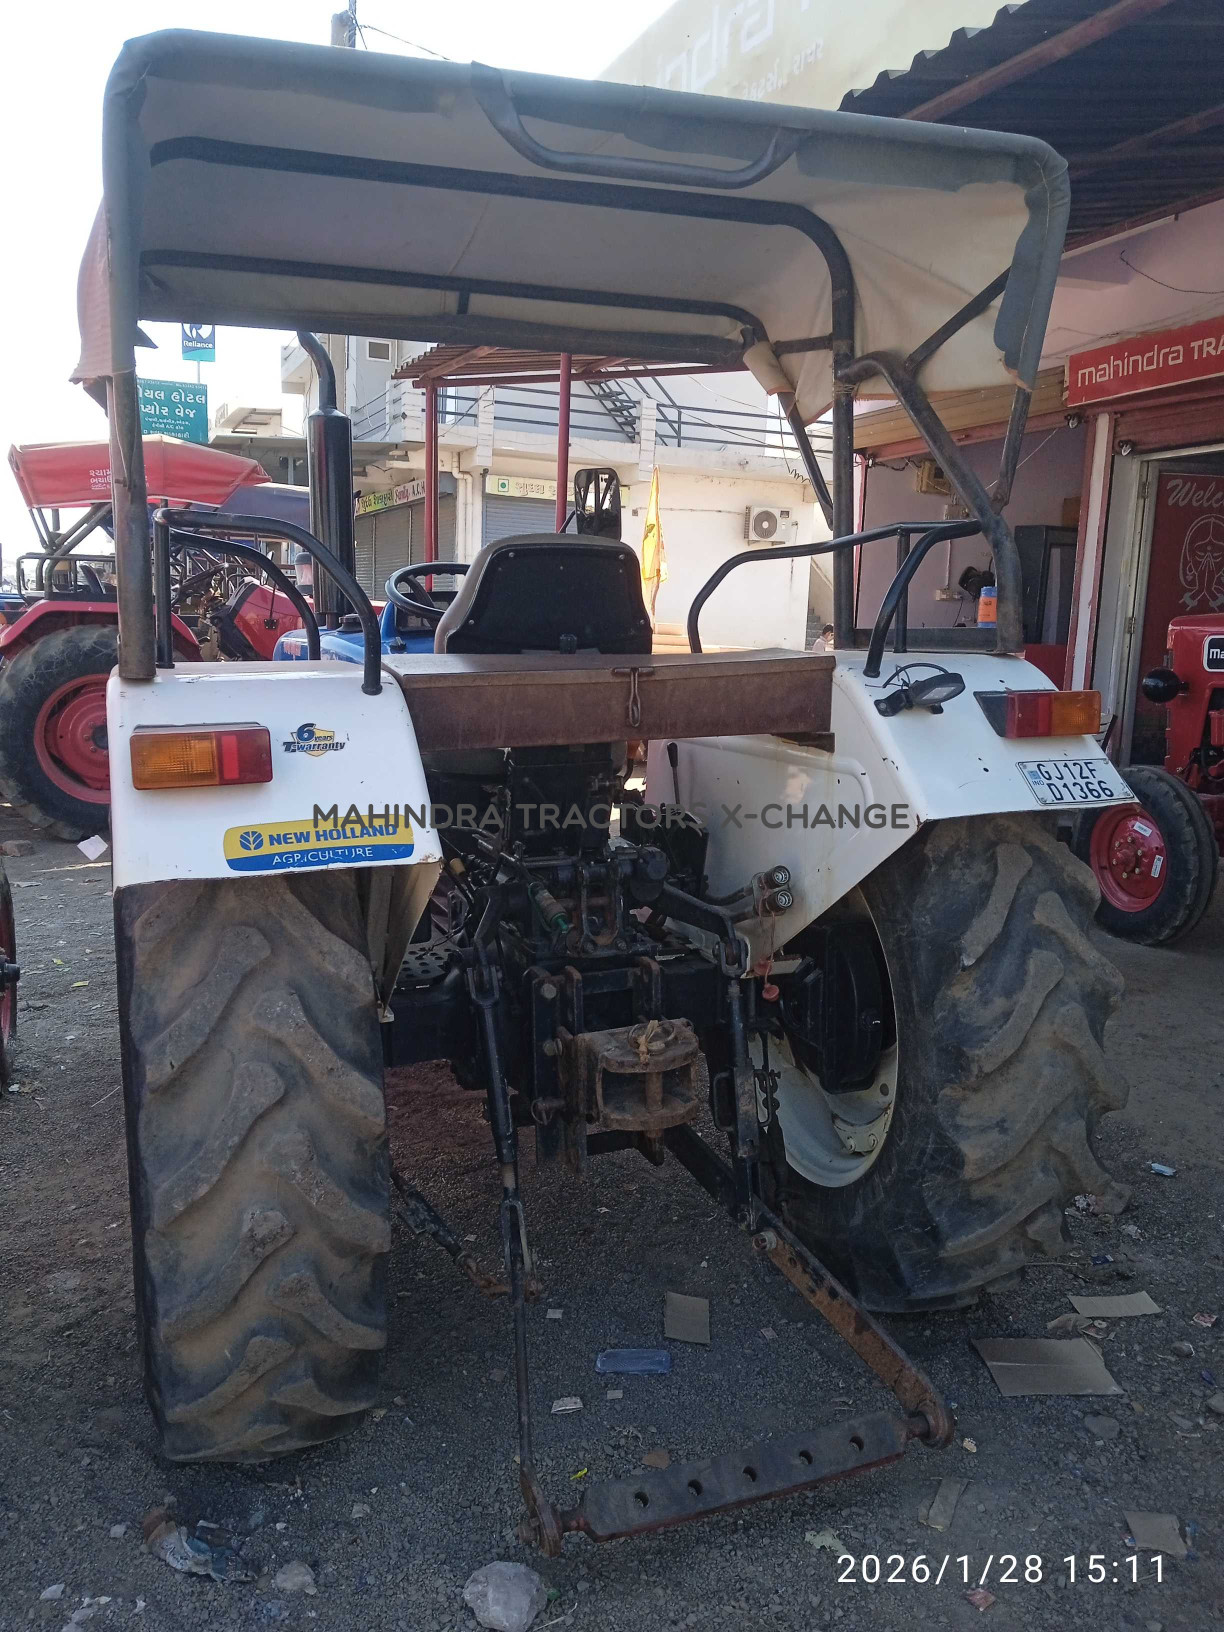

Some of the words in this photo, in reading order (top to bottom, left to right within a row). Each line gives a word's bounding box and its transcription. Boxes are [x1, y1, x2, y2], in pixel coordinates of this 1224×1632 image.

[183, 340, 213, 349] Reliance
[1078, 344, 1184, 387] mahindra
[297, 722, 316, 742] 6
[1036, 761, 1097, 781] GJ12F
[1046, 780, 1114, 801] D1366
[268, 830, 311, 846] NEW
[315, 824, 397, 842] HOLLAND
